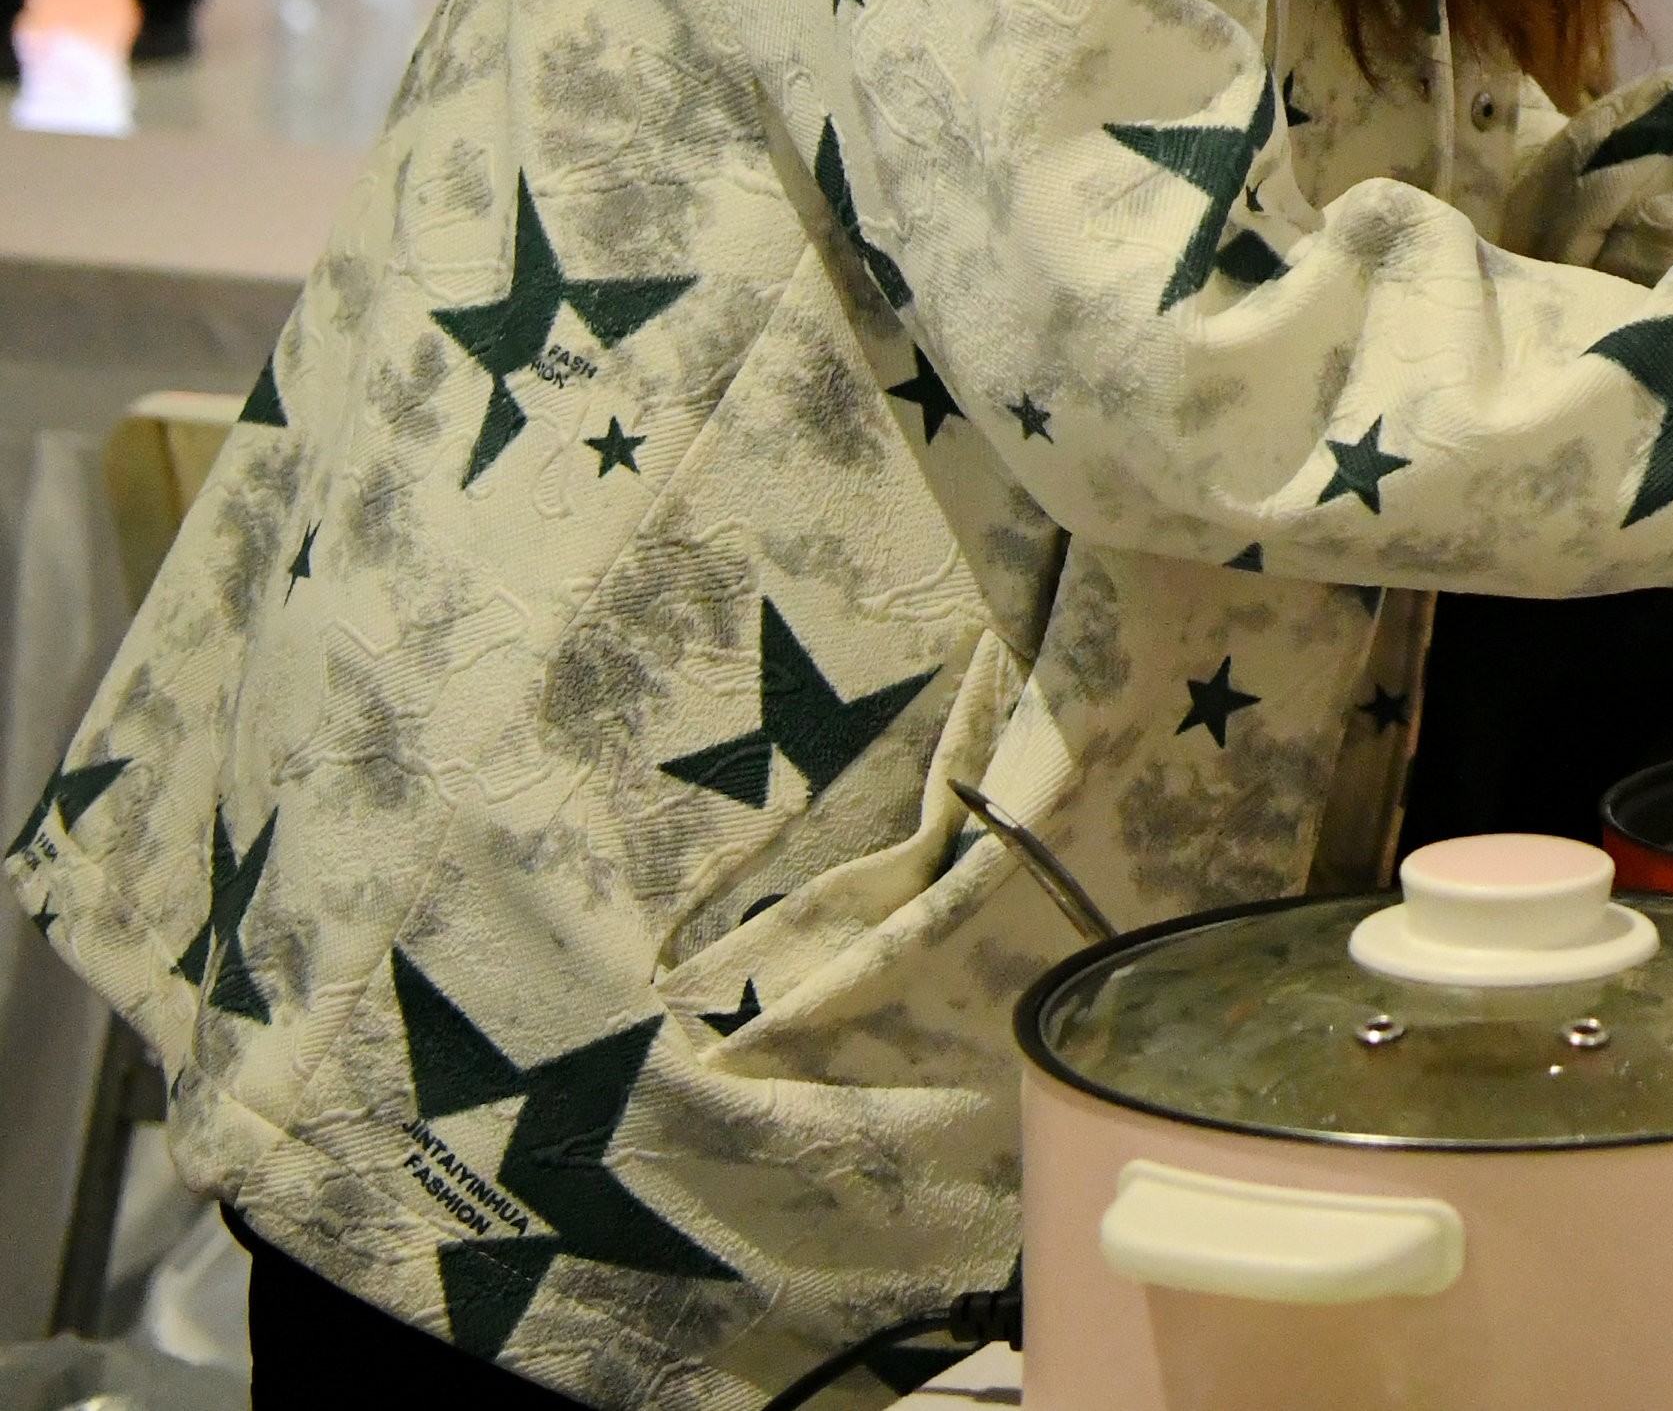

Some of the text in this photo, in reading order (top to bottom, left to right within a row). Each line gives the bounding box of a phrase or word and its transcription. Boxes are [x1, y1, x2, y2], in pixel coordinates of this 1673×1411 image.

[548, 344, 598, 379] FASH
[402, 1117, 530, 1236] JINTAIYINHUA
[403, 1153, 493, 1236] FASHION
